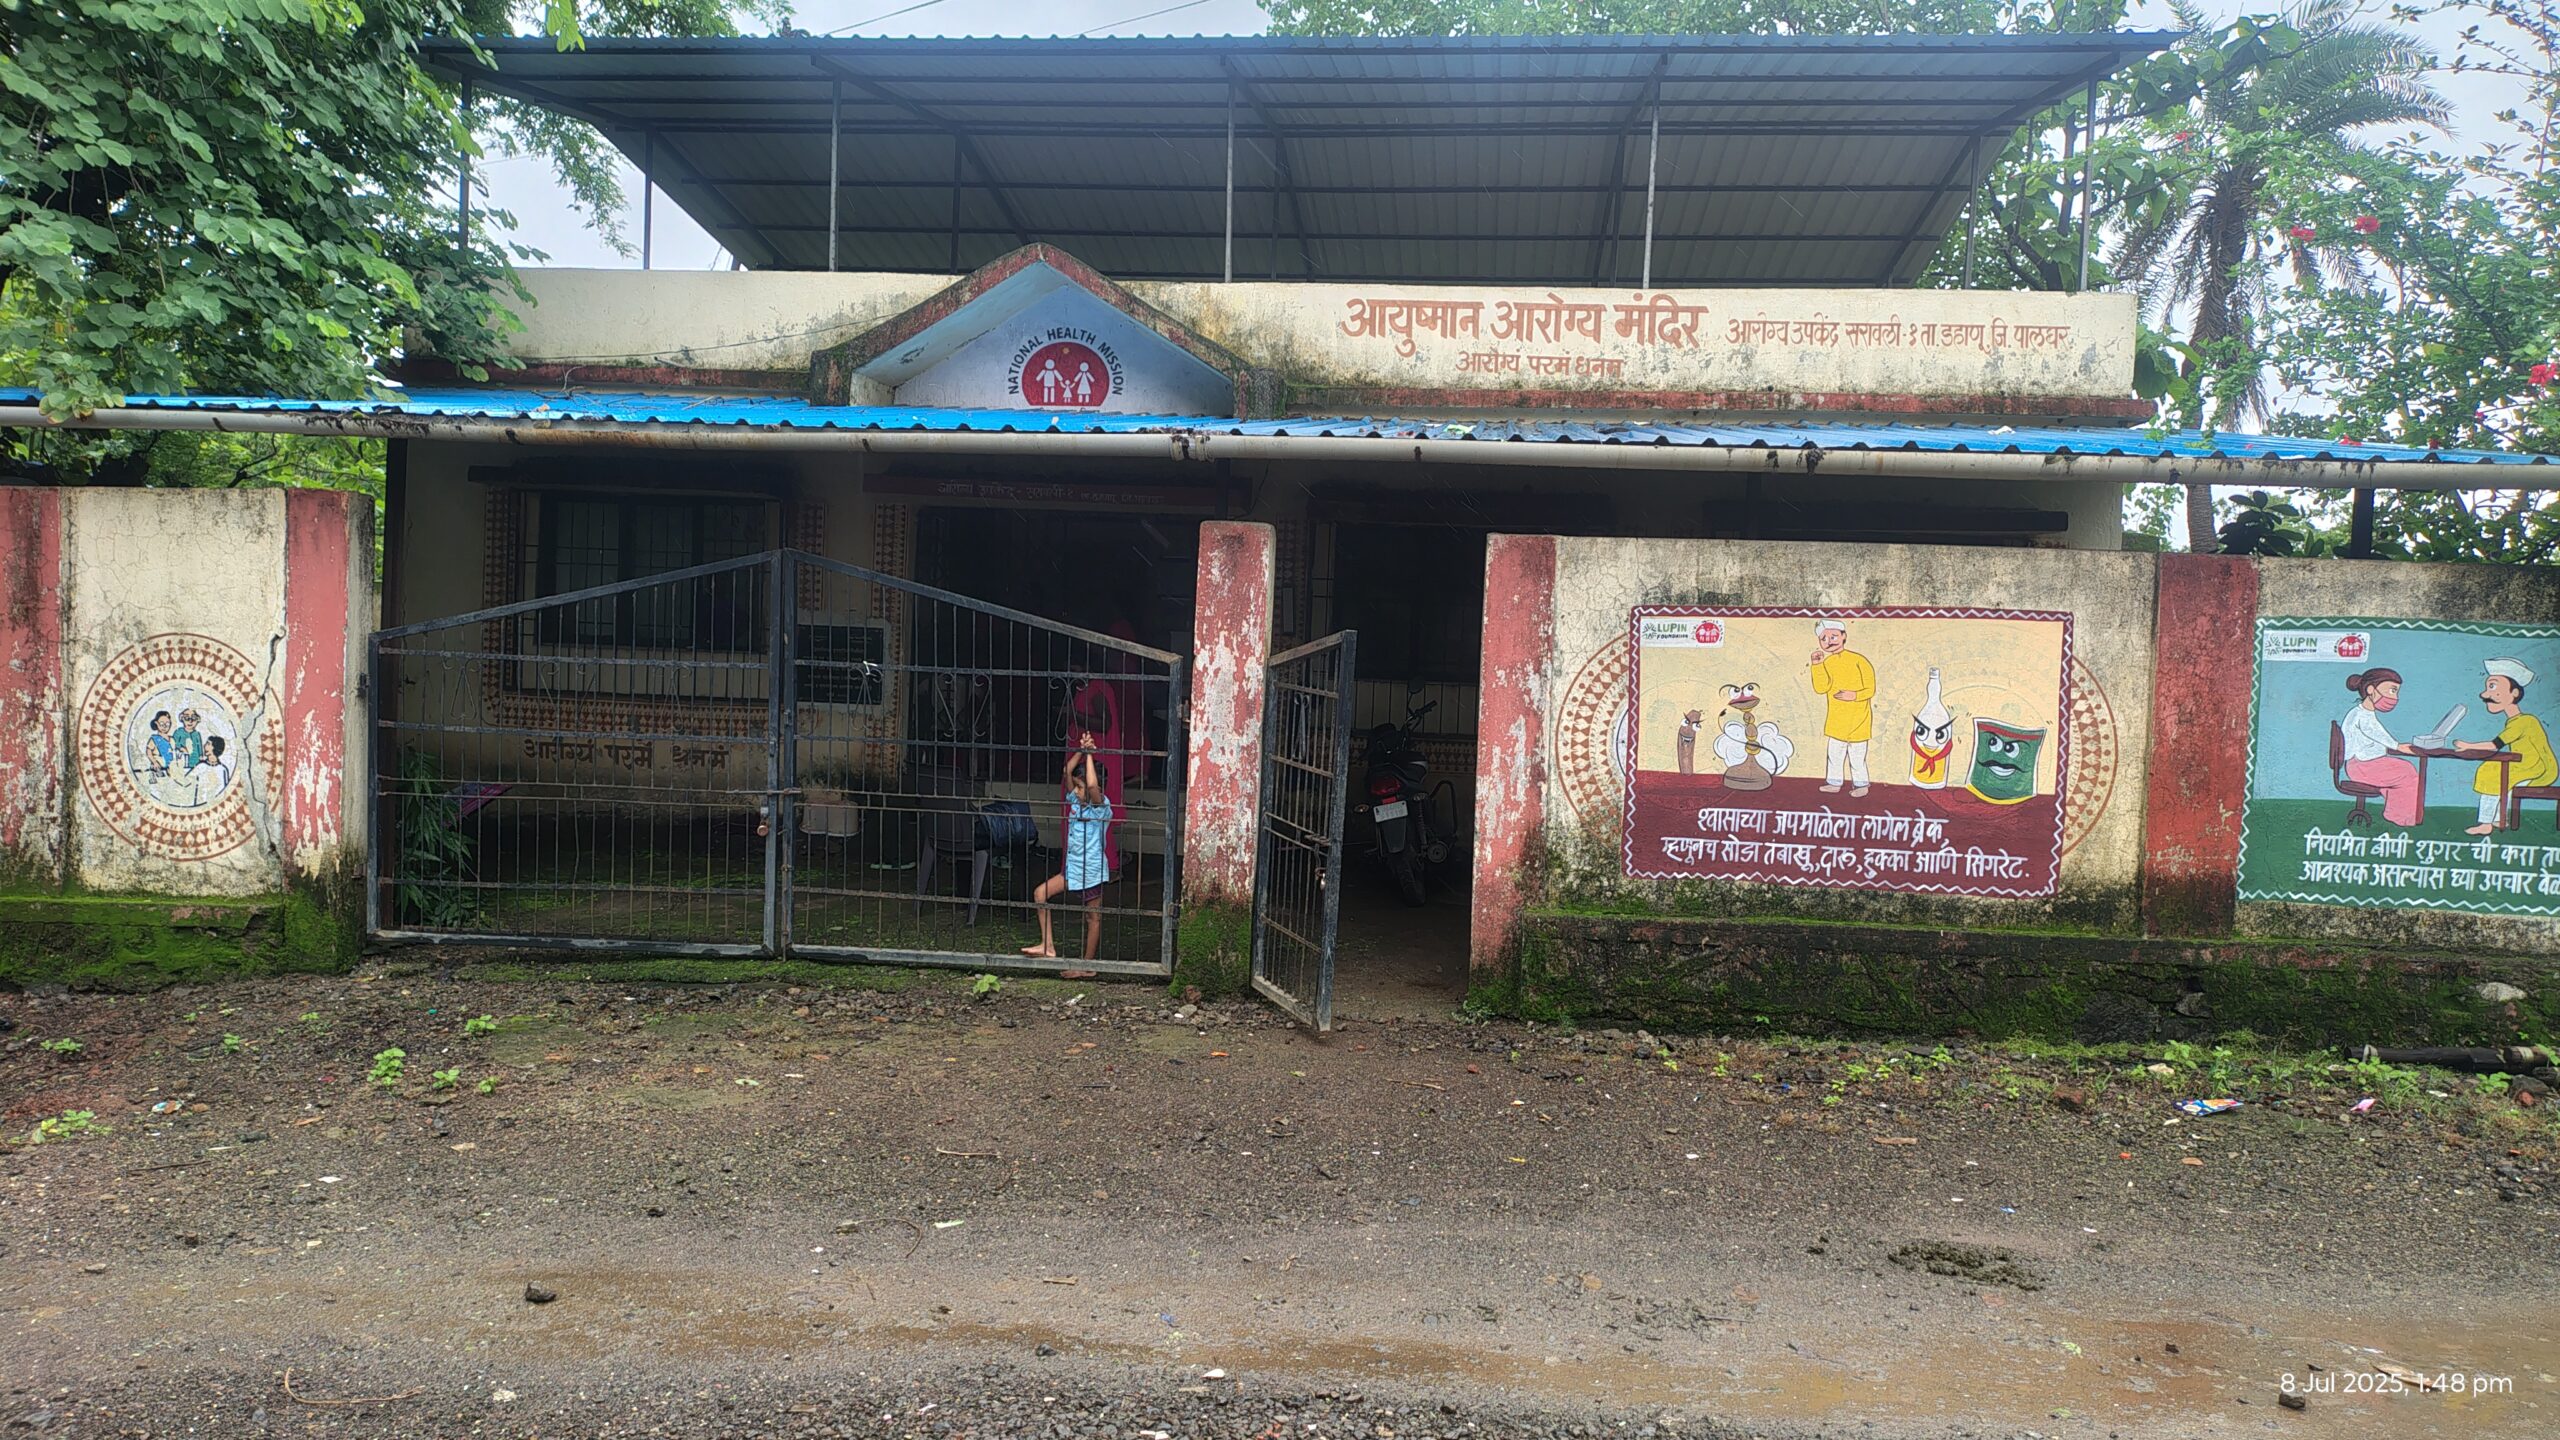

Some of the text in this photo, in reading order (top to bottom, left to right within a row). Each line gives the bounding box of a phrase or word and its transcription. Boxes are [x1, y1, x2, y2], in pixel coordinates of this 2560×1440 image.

[1341, 292, 1710, 358] आयुष्मान आरोग्य मंदिर
[1725, 312, 1790, 347] आरोग्य
[1008, 327, 1124, 396] NATIONAL HEALTH MISSION
[1657, 622, 1688, 632] LUPIN
[2282, 636, 2318, 647] LUPIN
[1697, 807, 1773, 834] श्वासाच्या
[1773, 805, 1861, 839] जपमाळेला
[1861, 809, 1912, 841] लागेल
[1720, 833, 1763, 863] सोडा
[1913, 846, 1963, 876] आणि
[2303, 826, 2370, 858] नियमित
[2415, 839, 2470, 865] शुगर
[2500, 844, 2540, 867] करा
[2298, 860, 2371, 885] आवश्यक
[2369, 863, 2448, 890] असल्यास
[2479, 869, 2538, 896] उपचार
